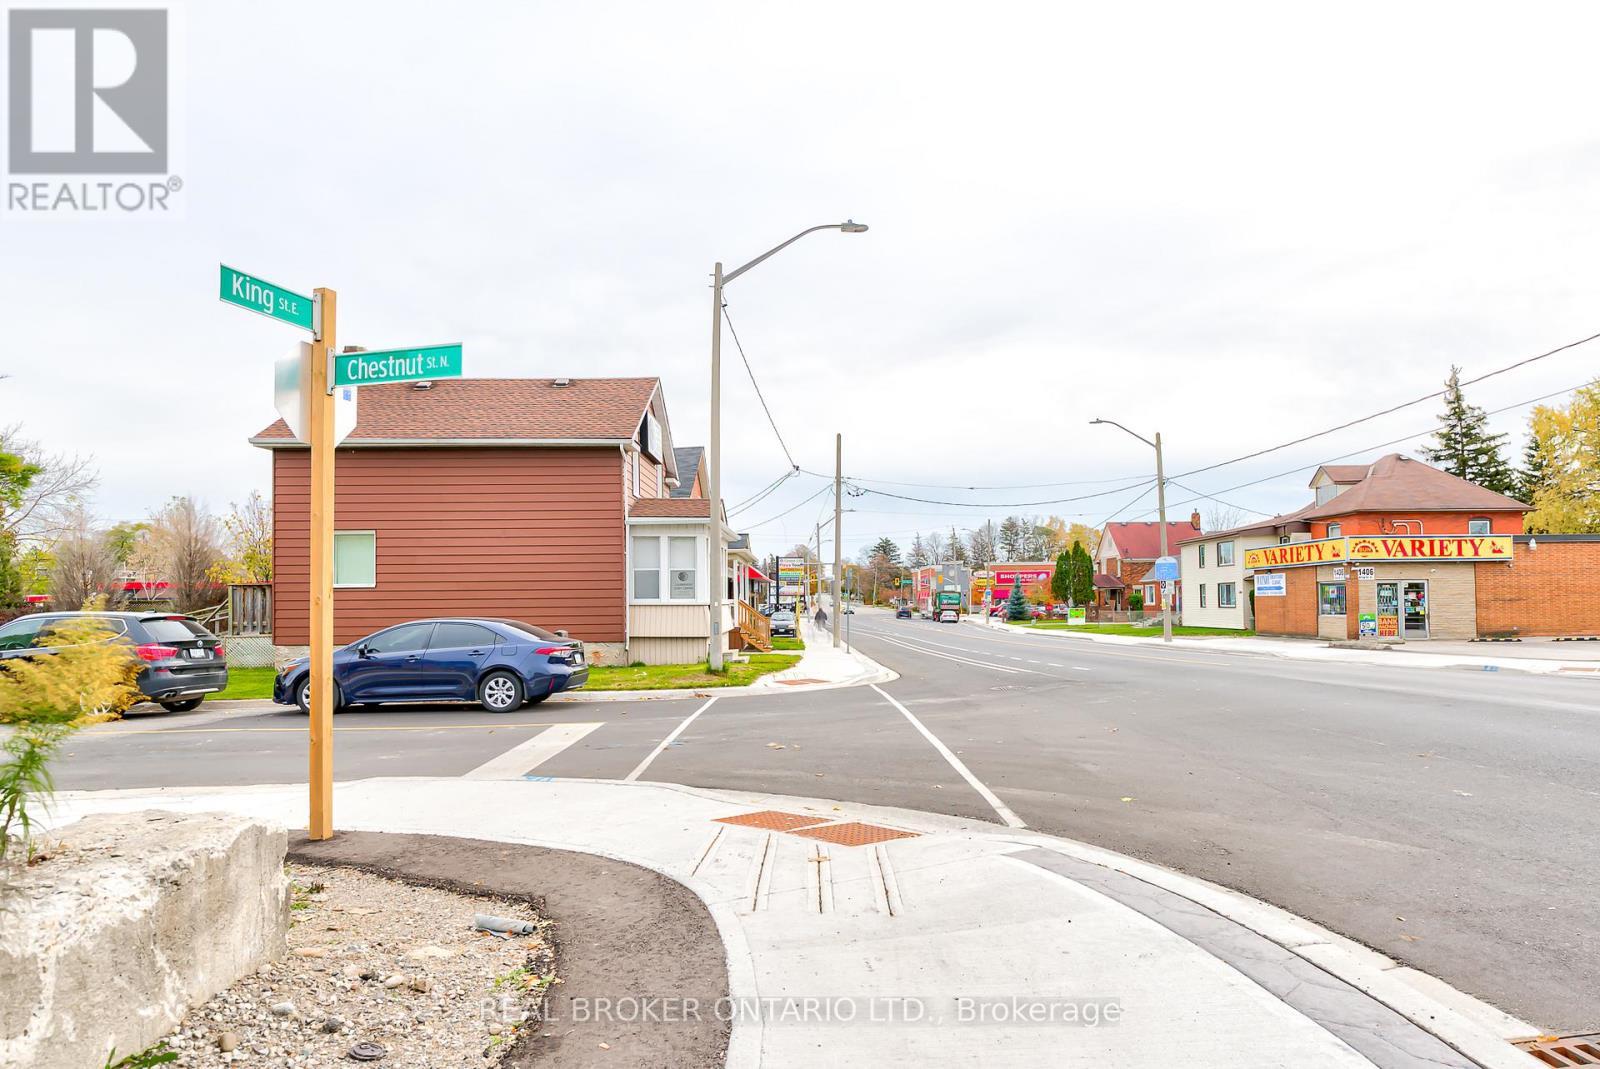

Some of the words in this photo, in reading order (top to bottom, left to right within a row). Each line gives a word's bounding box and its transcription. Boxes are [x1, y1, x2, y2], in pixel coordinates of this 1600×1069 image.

[232, 273, 274, 314] King
[347, 353, 424, 380] Chestnut
[426, 356, 439, 369] St.
[440, 355, 450, 368] N.
[1263, 543, 1326, 565] VARIETY
[1381, 538, 1485, 557] VARIETY
[1358, 568, 1374, 576] 1406
[1379, 617, 1398, 625] BANK
